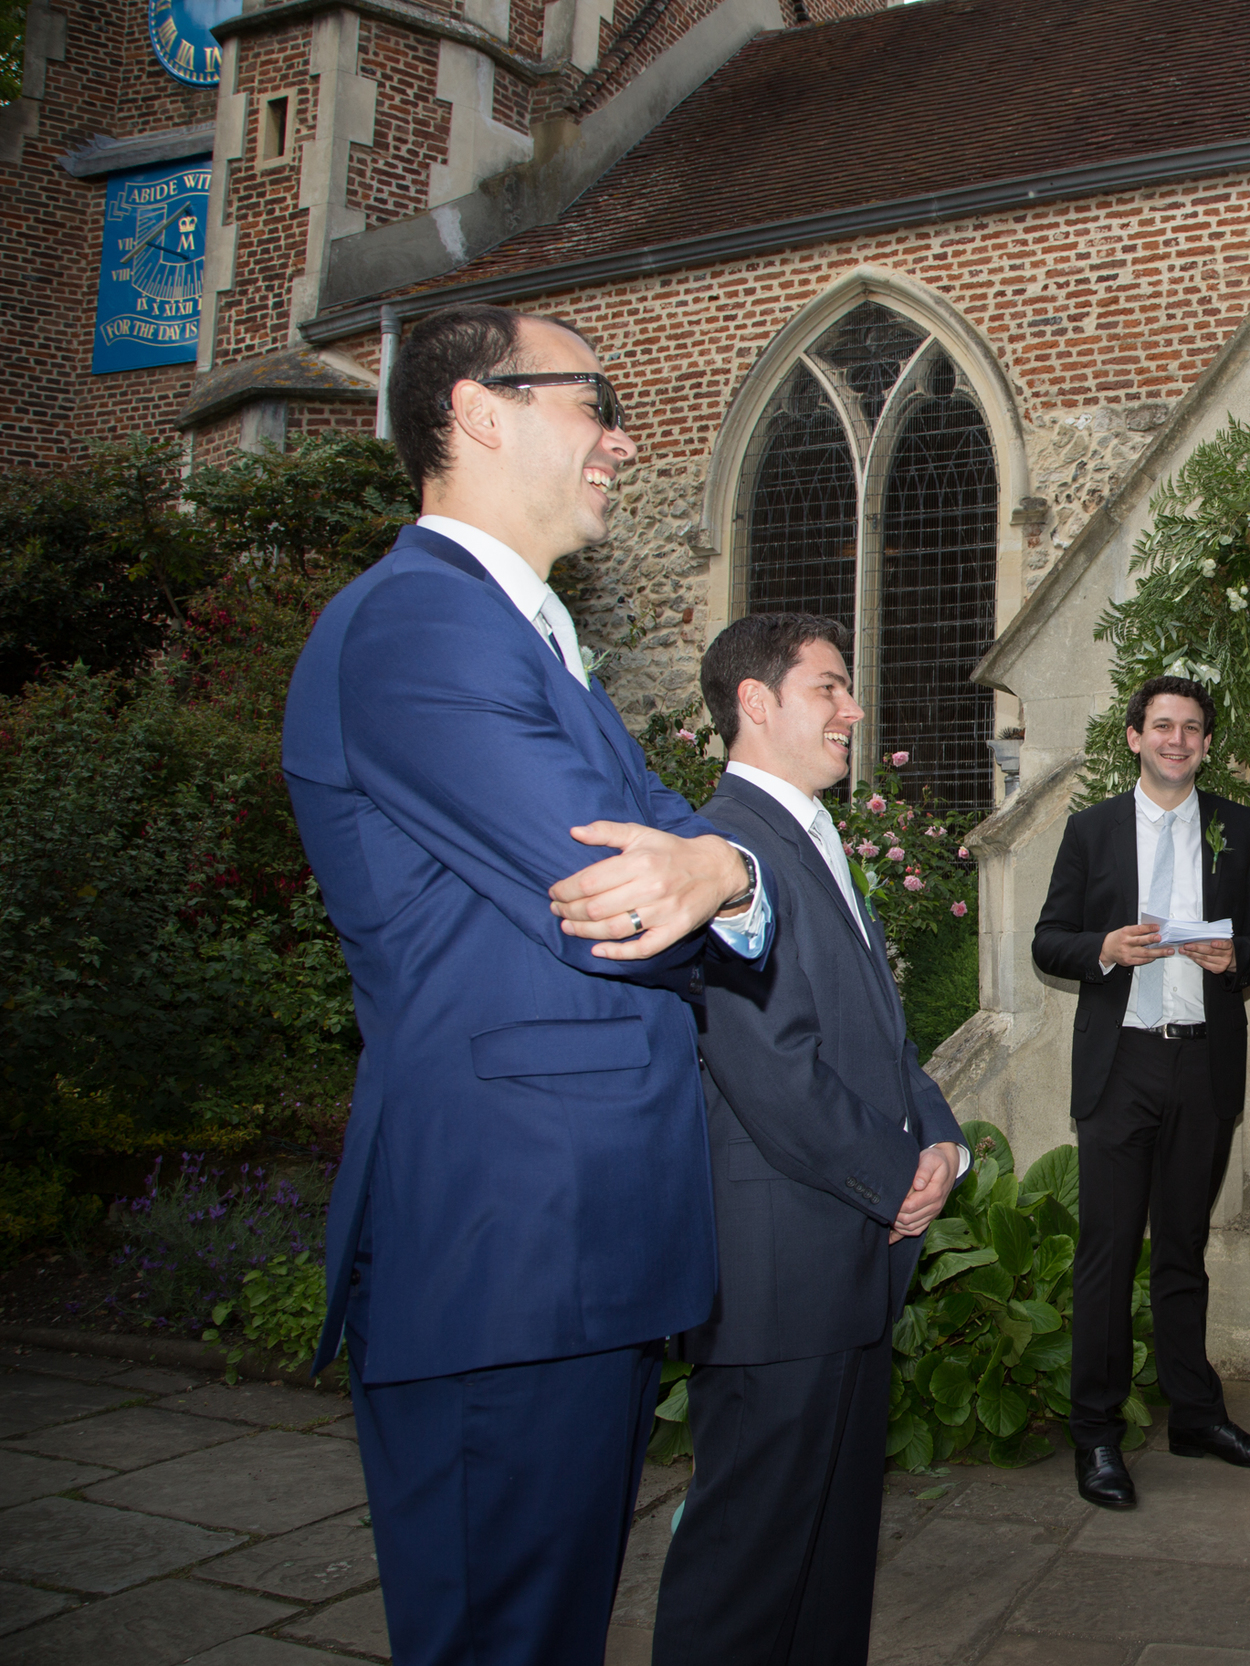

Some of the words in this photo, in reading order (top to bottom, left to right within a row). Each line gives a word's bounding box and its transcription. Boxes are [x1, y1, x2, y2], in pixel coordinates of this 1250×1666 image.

[129, 180, 178, 203] ABIDE
[182, 173, 212, 190] WIT
[118, 237, 133, 250] VII
[177, 233, 195, 252] M
[111, 268, 130, 281] VIII
[136, 297, 148, 311] IX
[151, 302, 160, 315] X
[163, 302, 176, 316] XI
[177, 301, 193, 316] XII
[106, 319, 131, 339] FOR
[132, 320, 157, 339] THE
[157, 324, 183, 340] DAY
[184, 321, 198, 338] IS
